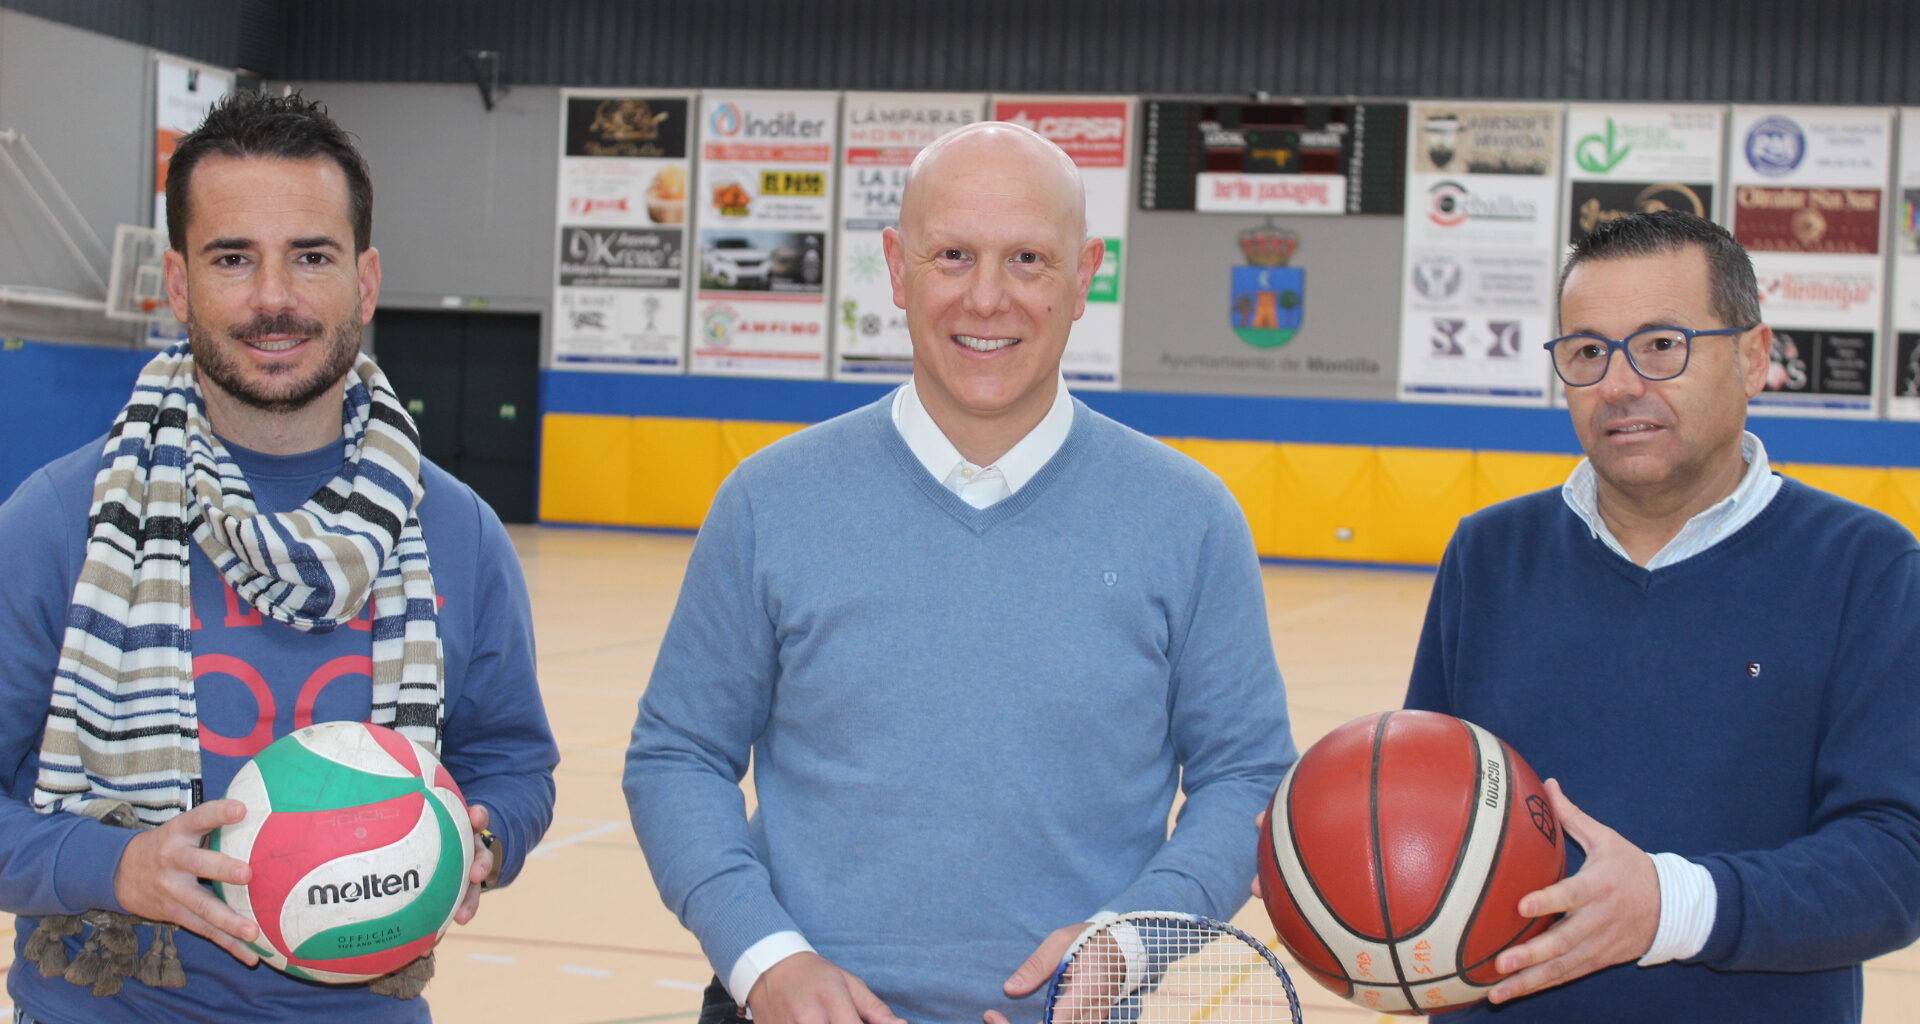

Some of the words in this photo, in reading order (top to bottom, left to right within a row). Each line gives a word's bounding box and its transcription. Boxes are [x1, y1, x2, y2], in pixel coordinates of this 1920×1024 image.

[1280, 354, 1300, 370] de
[1306, 356, 1380, 374] Montilla
[1485, 759, 1500, 809] BG3000
[308, 868, 420, 905] molten
[337, 925, 401, 944] OFFICIAL
